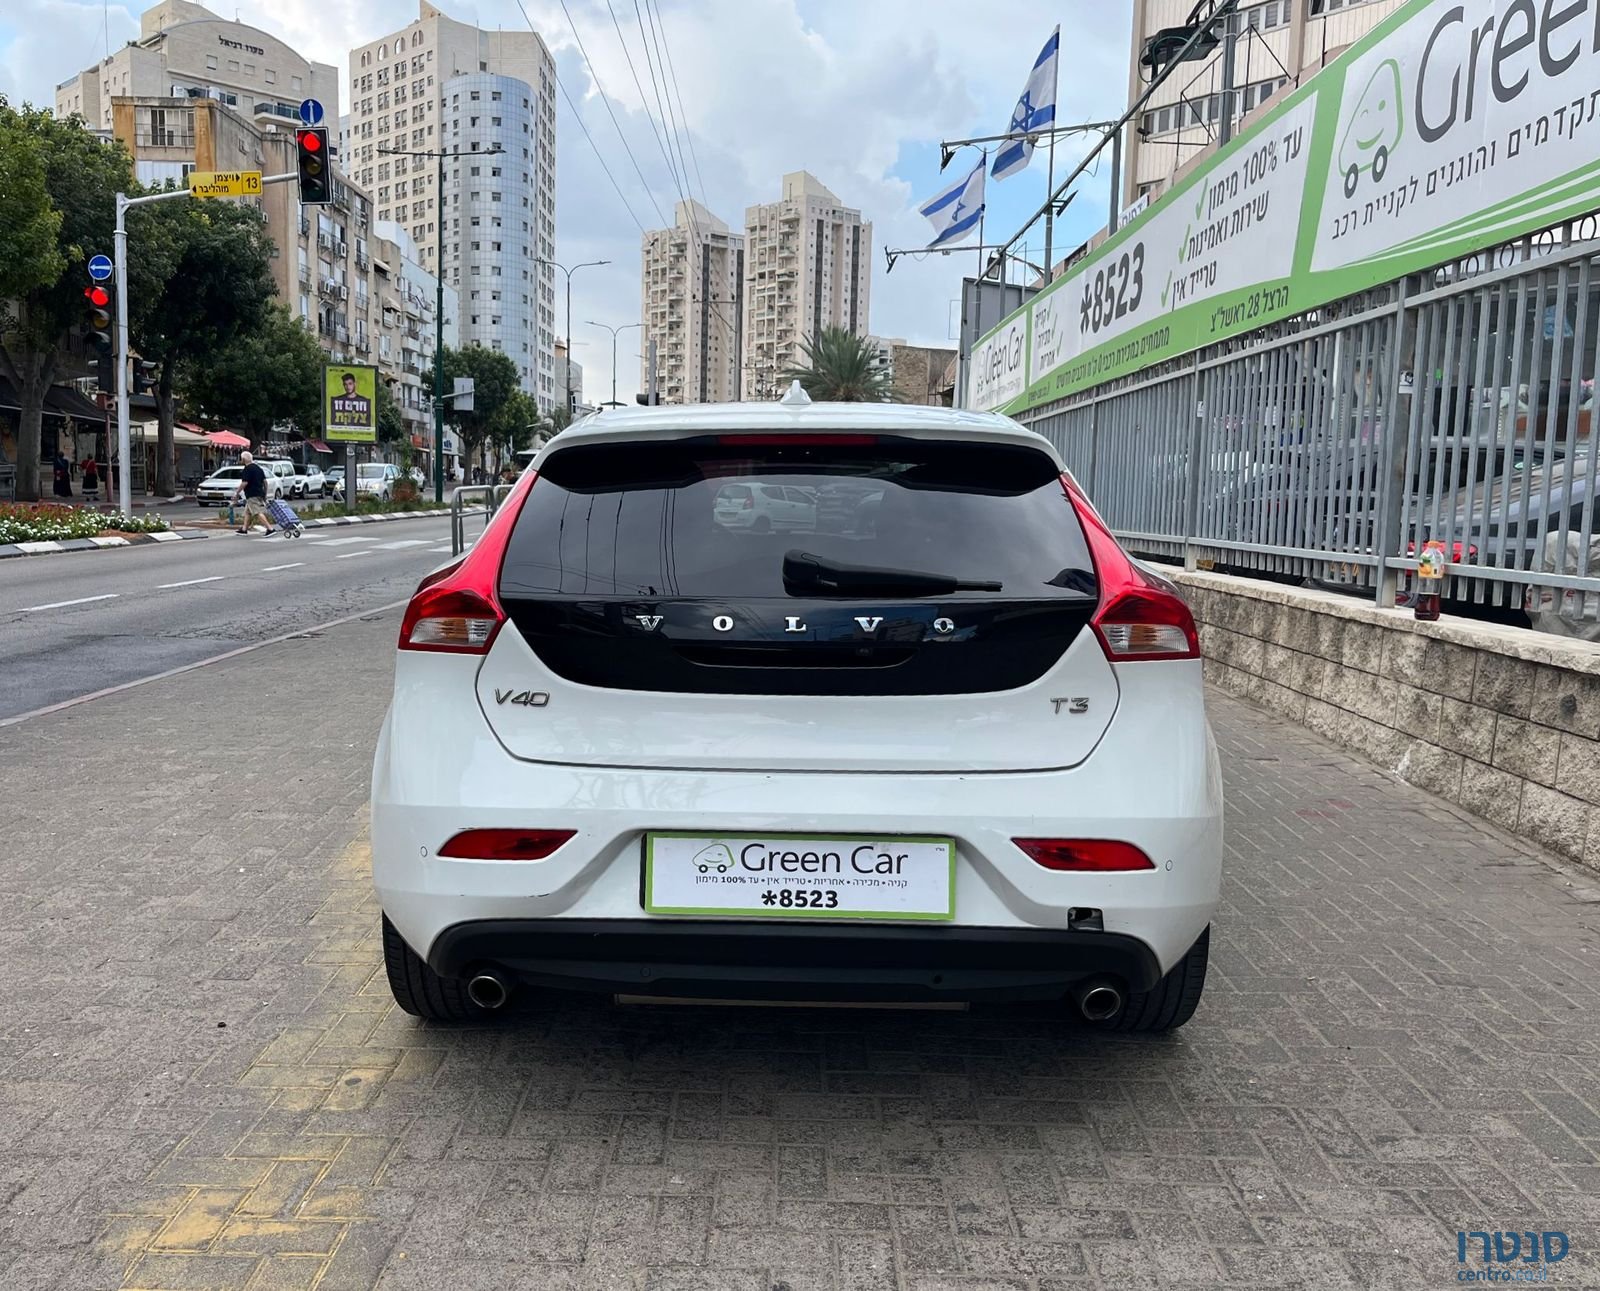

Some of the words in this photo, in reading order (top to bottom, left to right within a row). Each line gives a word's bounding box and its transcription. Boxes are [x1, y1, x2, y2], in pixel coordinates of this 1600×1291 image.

[219, 35, 242, 49] דניאל
[1415, 0, 1600, 142] Gree
[1283, 126, 1303, 163] עד
[1243, 140, 1278, 189] 100%
[1426, 140, 1496, 197] והוגנים
[214, 173, 235, 184] ויצמן
[246, 177, 258, 189] 13
[199, 184, 229, 193] מוהליבר
[1208, 171, 1238, 220] מימון
[1362, 175, 1418, 226] לקניית
[1230, 190, 1269, 238] שירות
[1331, 209, 1357, 240] רכב
[1187, 215, 1229, 261] ואמינות
[1190, 260, 1217, 295] טרייד
[1171, 276, 1187, 312] אין
[1262, 285, 1289, 314] הרצל
[1247, 292, 1260, 319] 28
[1008, 326, 1024, 372] Car
[345, 400, 367, 411] חרם
[335, 410, 367, 425] צלקת
[636, 615, 955, 634] VOLVO
[495, 688, 550, 707] V40
[1050, 697, 1089, 715] T3
[740, 843, 841, 873] Green
[850, 845, 909, 875] Car
[695, 875, 718, 884] מימון
[721, 876, 746, 884] 100%
[748, 876, 759, 884] עד
[767, 877, 780, 885] אין
[782, 877, 806, 885] טרייד
[852, 879, 880, 887] מכירה
[887, 879, 908, 889] קניה
